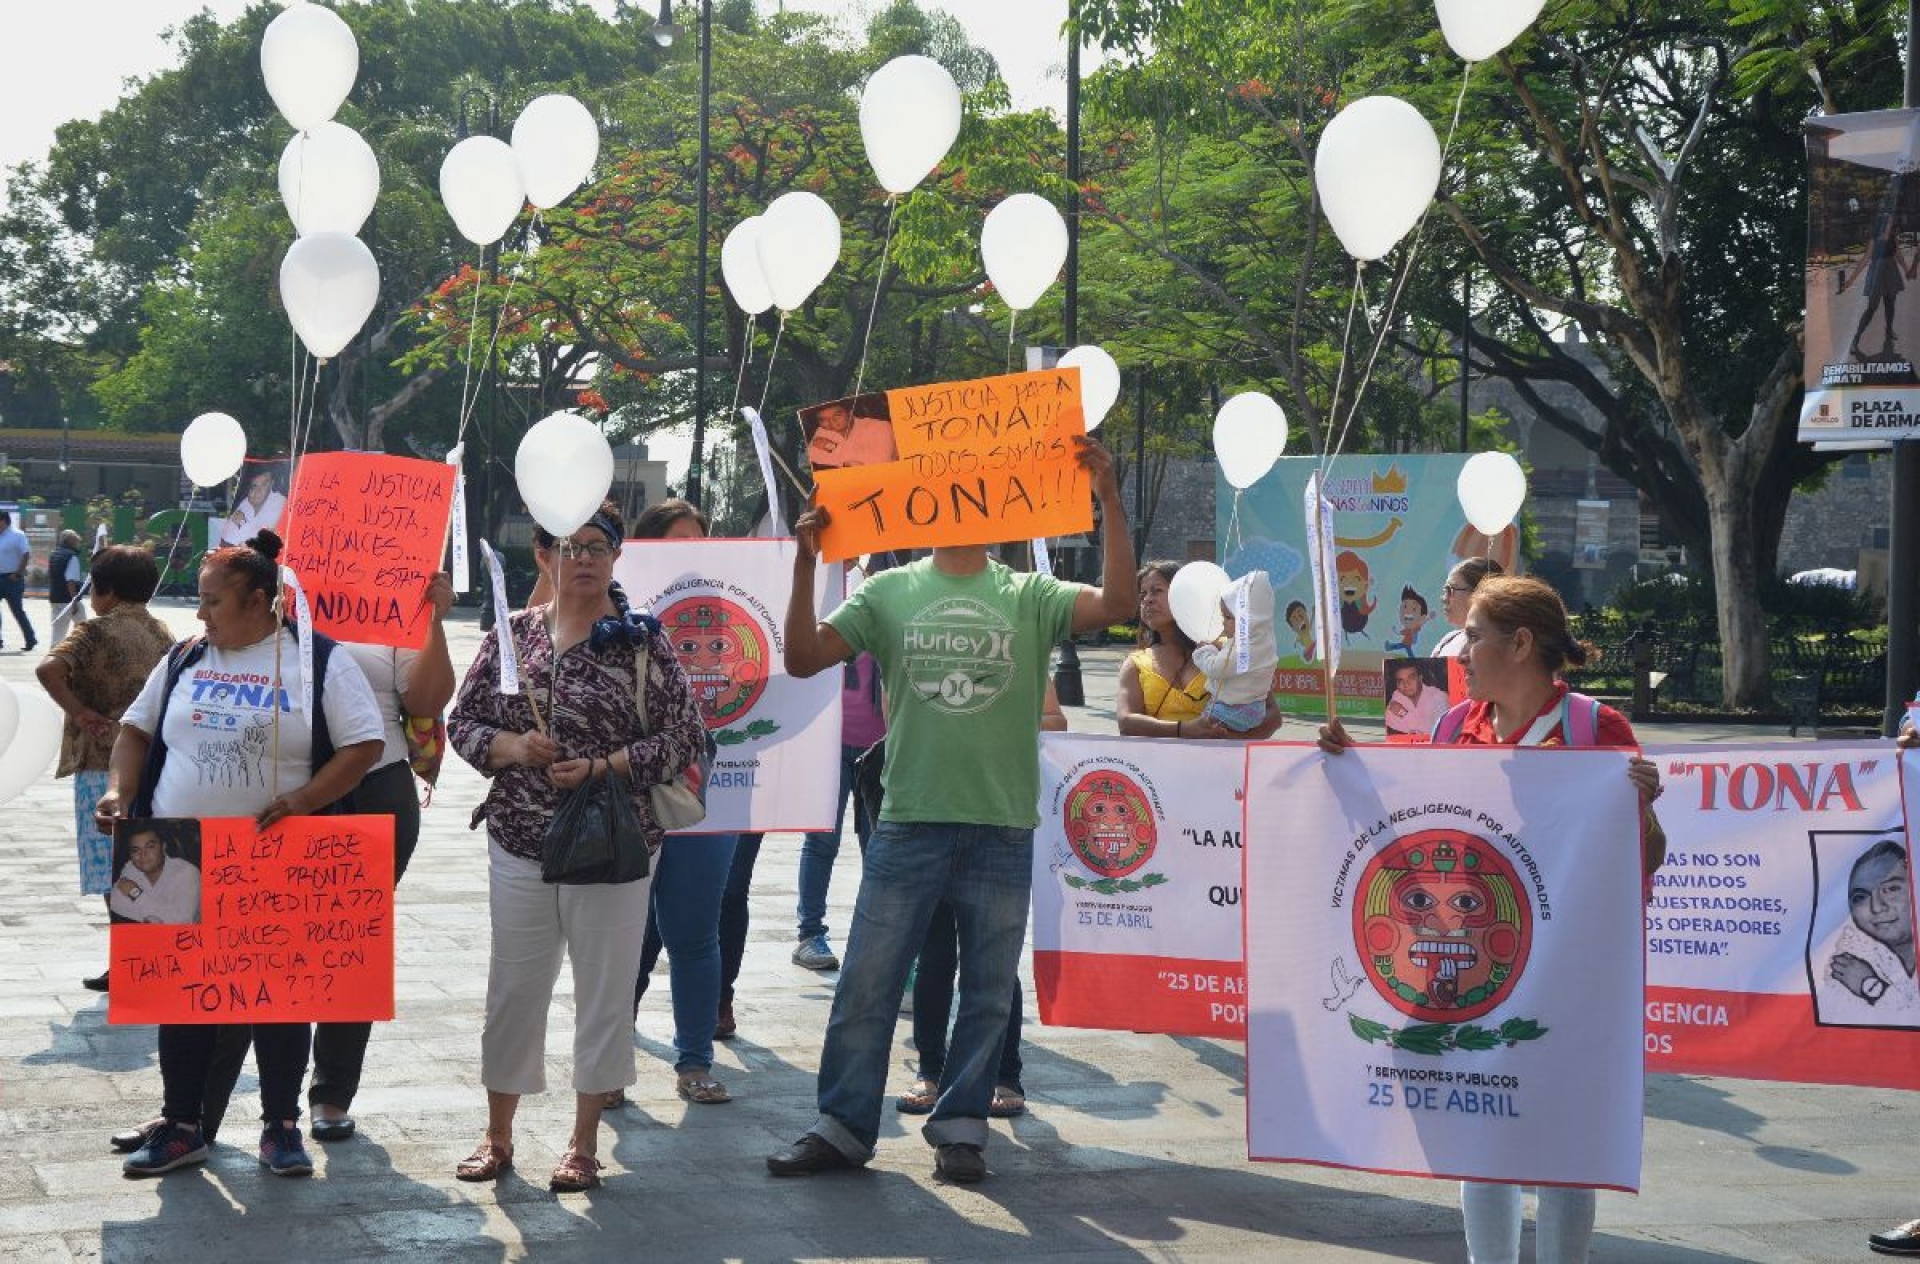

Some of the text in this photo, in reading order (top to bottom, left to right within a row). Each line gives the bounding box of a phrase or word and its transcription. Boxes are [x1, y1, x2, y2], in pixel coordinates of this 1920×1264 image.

[902, 384, 1000, 420] JUSTICIA
[1851, 401, 1903, 413] PLAZA
[912, 402, 1062, 442] TONA!!!
[1851, 414, 1920, 428] DE ARMA
[359, 469, 443, 502] JUSTICIA
[848, 468, 1077, 536] TONA!!!
[1370, 496, 1409, 512] NIÑOS
[663, 578, 724, 597] NEGLIGENCIA
[903, 628, 985, 655] Hurley
[193, 669, 269, 685] BUSCANDO
[191, 679, 291, 713] TONA
[709, 771, 763, 788] ABRIL
[213, 832, 362, 861] LA LEY DEBE
[1331, 803, 1551, 921] VICTIMAS DE LA NEGLIGENCIA POR AUTORIDADES
[1693, 853, 1719, 867] NO
[1723, 854, 1761, 867] SON
[286, 862, 366, 889] PRONTA
[216, 892, 225, 918] Y
[1208, 885, 1243, 907] QU
[1077, 911, 1153, 929] 25 DE ABRIL
[1667, 918, 1782, 936] OPERADORES
[121, 948, 365, 984] TANTA INJUSTICIA CON
[1194, 974, 1220, 993] DE
[1366, 1064, 1519, 1089] Y SERVIDORES PUBLICOS
[1368, 1082, 1520, 1118] 25 DE ABRIL
